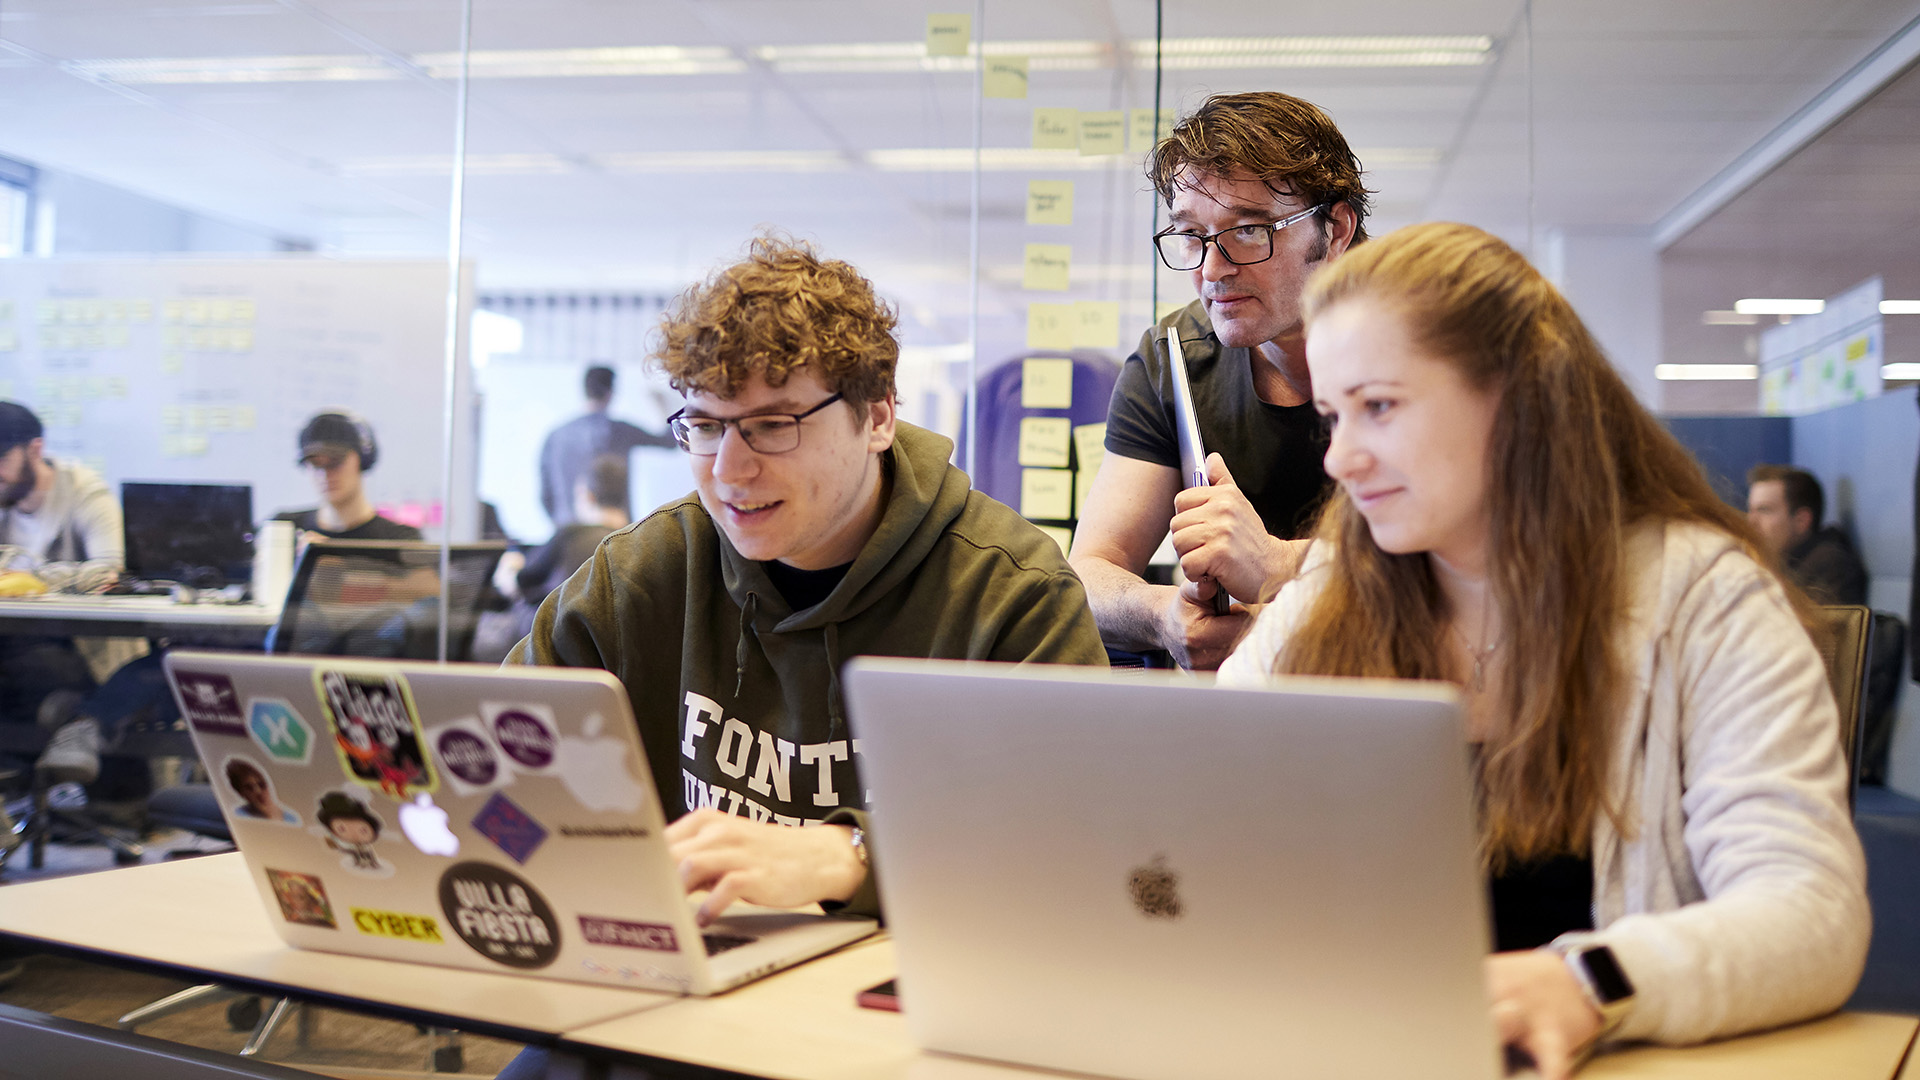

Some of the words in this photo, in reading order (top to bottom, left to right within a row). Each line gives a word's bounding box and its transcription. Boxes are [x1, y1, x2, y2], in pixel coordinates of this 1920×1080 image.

[682, 691, 869, 807] FONT
[451, 879, 533, 914] VILLA
[353, 910, 442, 941] CYBER
[455, 908, 553, 945] FIESTA
